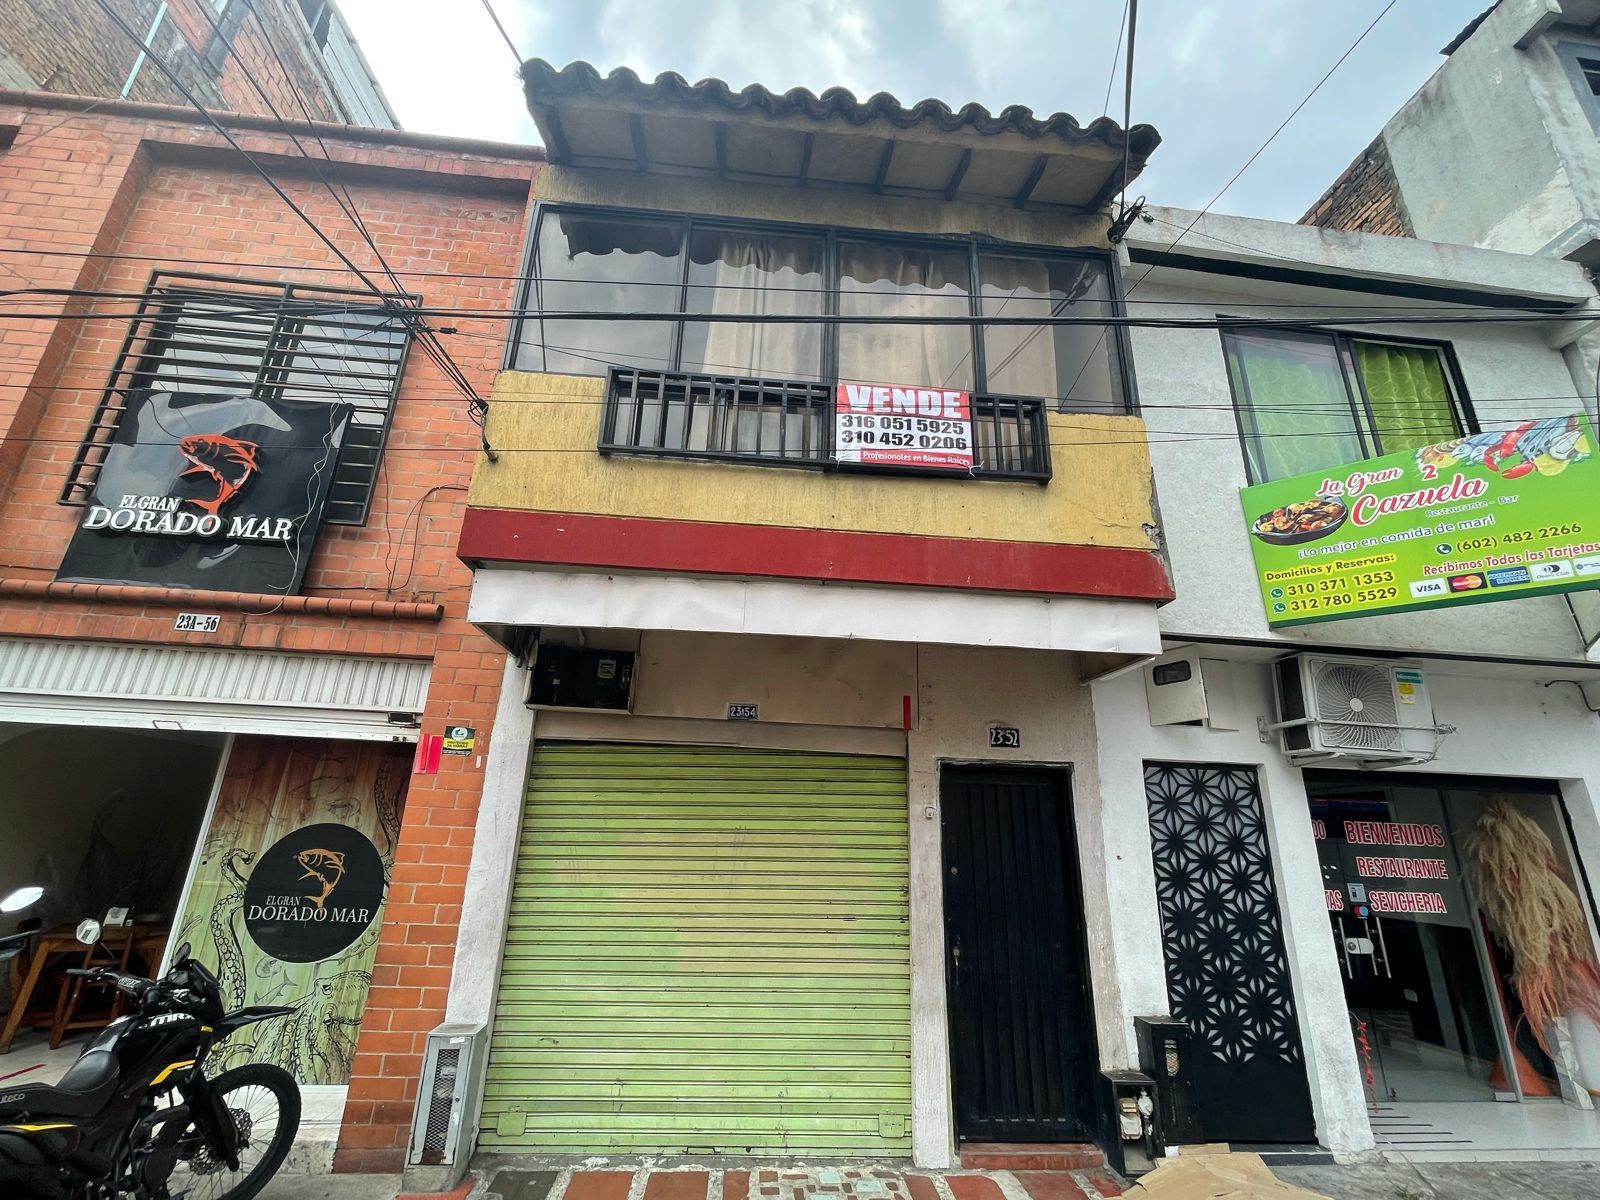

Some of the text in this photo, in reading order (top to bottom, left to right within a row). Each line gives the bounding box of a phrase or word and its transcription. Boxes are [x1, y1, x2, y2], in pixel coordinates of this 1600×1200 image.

[845, 385, 962, 419] VENDE
[841, 415, 964, 435] 316 051 5925
[841, 430, 967, 450] 310 452 0206
[863, 451, 912, 462] Profesionales
[923, 455, 947, 464] Bienes
[1317, 467, 1401, 495] La Gran
[1422, 465, 1437, 480] 2
[119, 494, 181, 511] EL GRAN
[1351, 474, 1488, 526] Cazuela
[1426, 500, 1488, 517] Restaurante
[1499, 495, 1518, 504] Bar
[83, 506, 293, 540] DORADO MAR
[1321, 541, 1358, 554] mejor
[1361, 538, 1378, 547] en
[1381, 528, 1432, 544] comida
[1436, 523, 1454, 533] de
[1459, 515, 1495, 530] mar!
[1456, 523, 1582, 553] (602) 482 2266
[1266, 554, 1395, 581] Domicilios y Reservas:
[1424, 543, 1600, 575] Recibimos Todas las Tarjetas
[1287, 571, 1394, 596] 310 371 1353
[1416, 583, 1442, 593] VISA
[1290, 587, 1397, 611] 312 780 5529
[176, 614, 219, 631] 23A-56
[1343, 820, 1446, 848] BIENVENIDOS
[1355, 856, 1449, 880] RESTAURANTE
[265, 895, 301, 906] EL GRAN
[1368, 890, 1448, 914] SEVICHERIA
[247, 905, 370, 923] DORADO MAR
